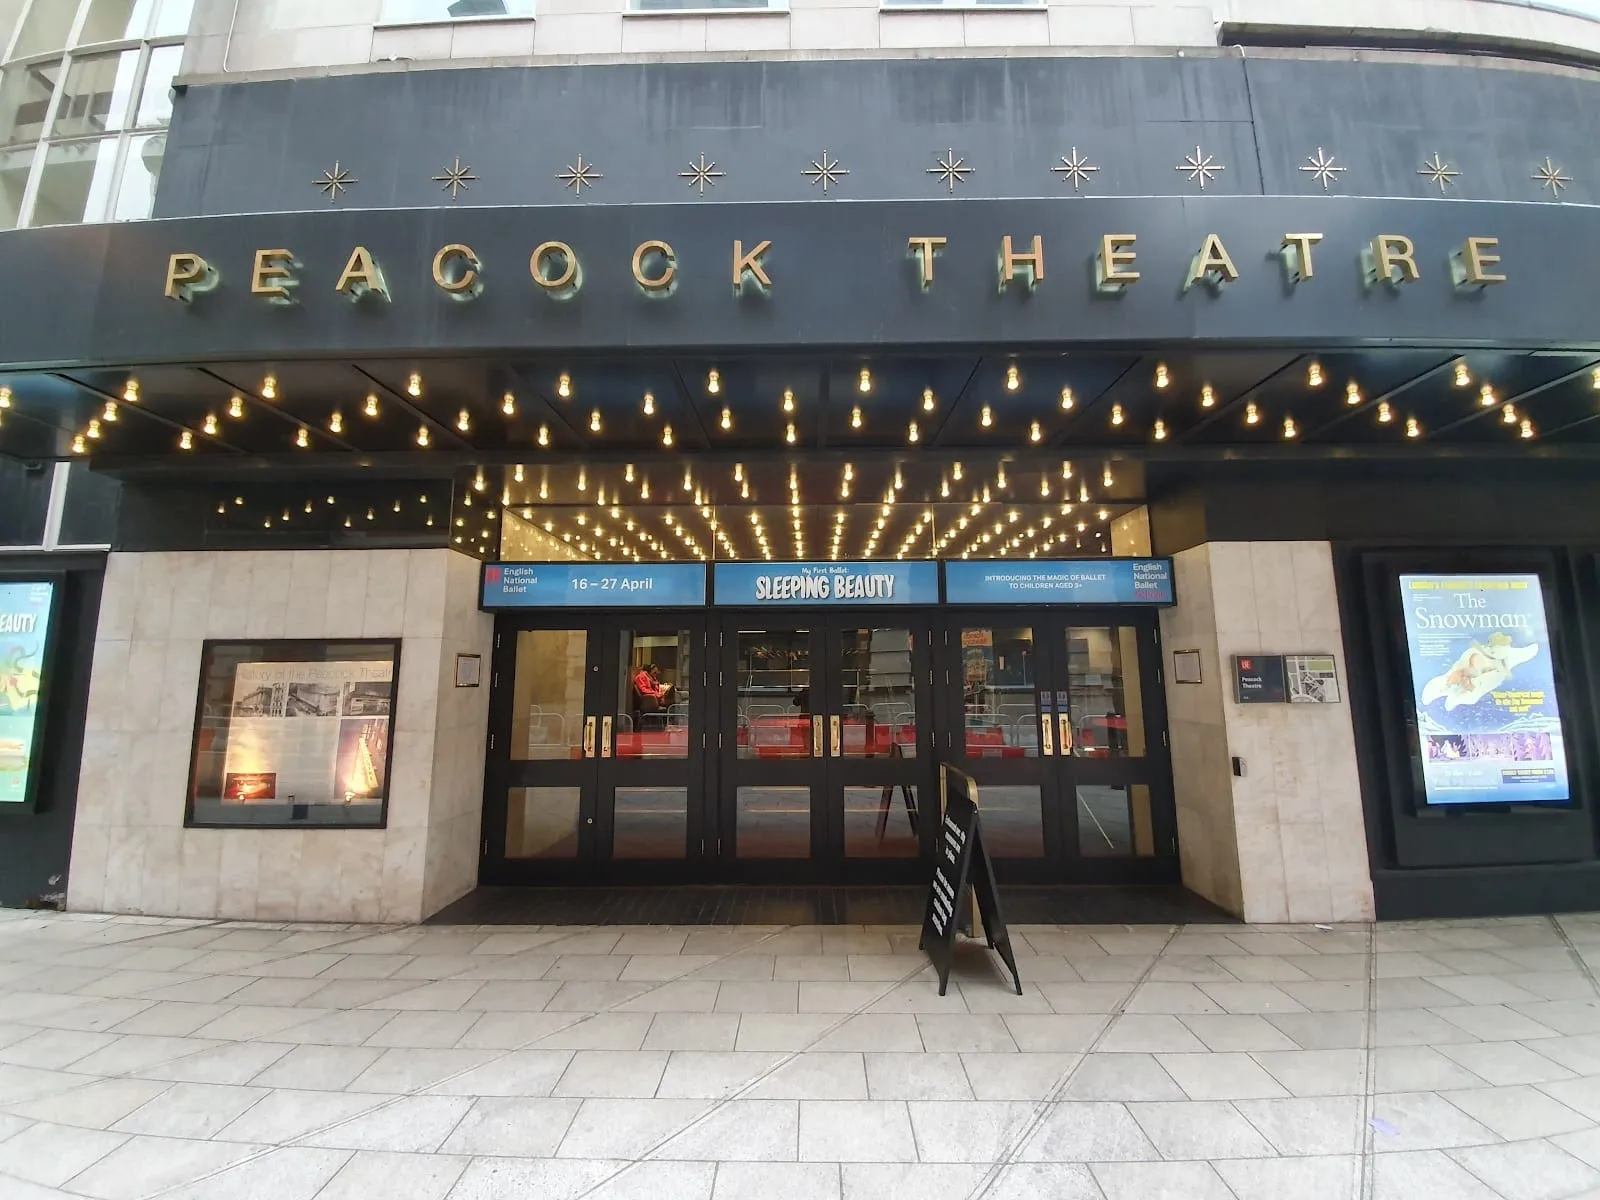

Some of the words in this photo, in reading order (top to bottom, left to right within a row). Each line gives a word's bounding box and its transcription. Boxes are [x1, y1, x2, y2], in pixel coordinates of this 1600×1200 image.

[163, 239, 773, 300] PEACOCK
[908, 232, 1507, 287] THEATRE
[503, 567, 534, 576] English
[801, 567, 811, 576] My
[813, 566, 828, 574] First
[1133, 563, 1162, 572] English
[503, 576, 538, 585] National
[1134, 572, 1168, 580] National
[502, 585, 527, 593] Ballet
[572, 578, 588, 590] 16
[600, 578, 617, 590] 27
[620, 577, 653, 592] April
[755, 575, 830, 600] SLEEPING
[834, 574, 895, 599] BEAUTY
[1135, 581, 1158, 589] Ballet
[1453, 593, 1486, 609] The
[0, 613, 38, 633] EAUTY
[1415, 607, 1529, 629] Snowman
